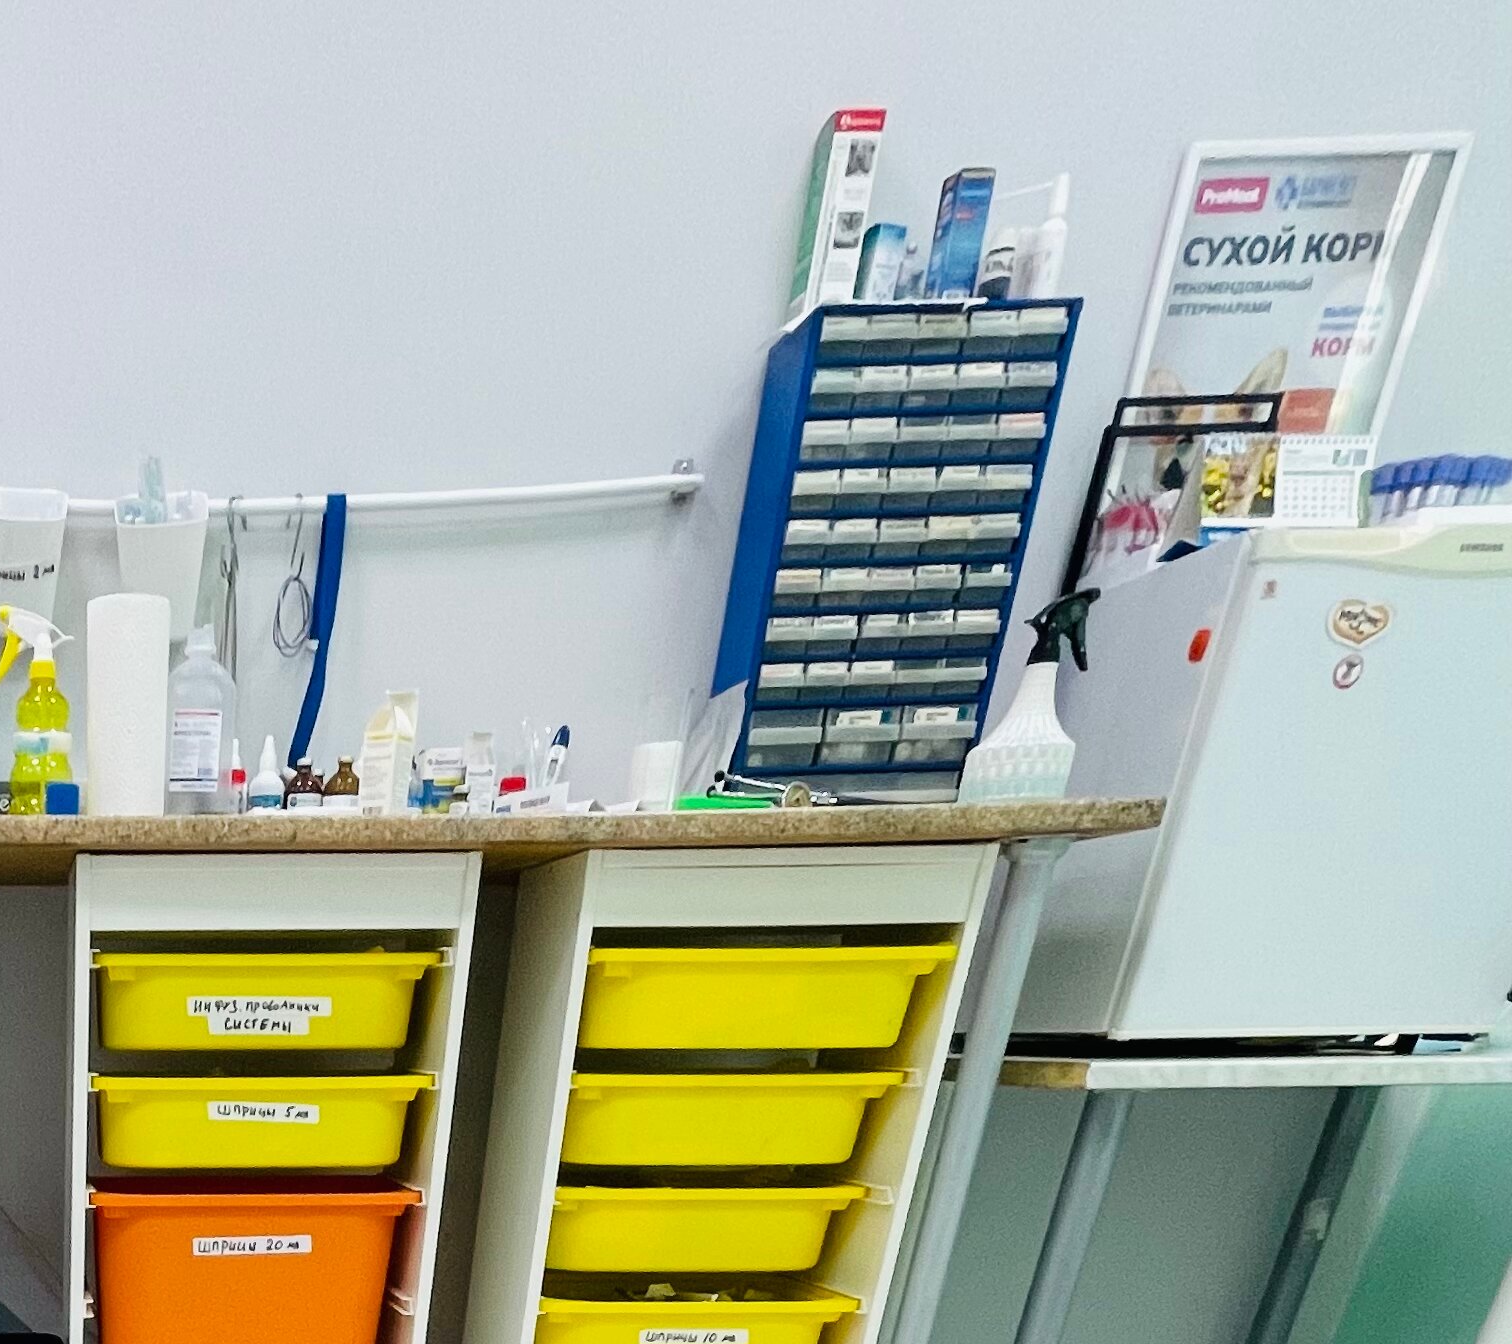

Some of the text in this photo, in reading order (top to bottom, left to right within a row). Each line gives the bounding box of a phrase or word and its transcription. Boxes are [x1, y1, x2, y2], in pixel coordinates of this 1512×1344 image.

[1183, 224, 1296, 267] СУХОЙ
[33, 564, 40, 579] 2
[285, 1105, 296, 1118] 5
[266, 1238, 284, 1251] 20
[702, 1332, 718, 1344] 10
